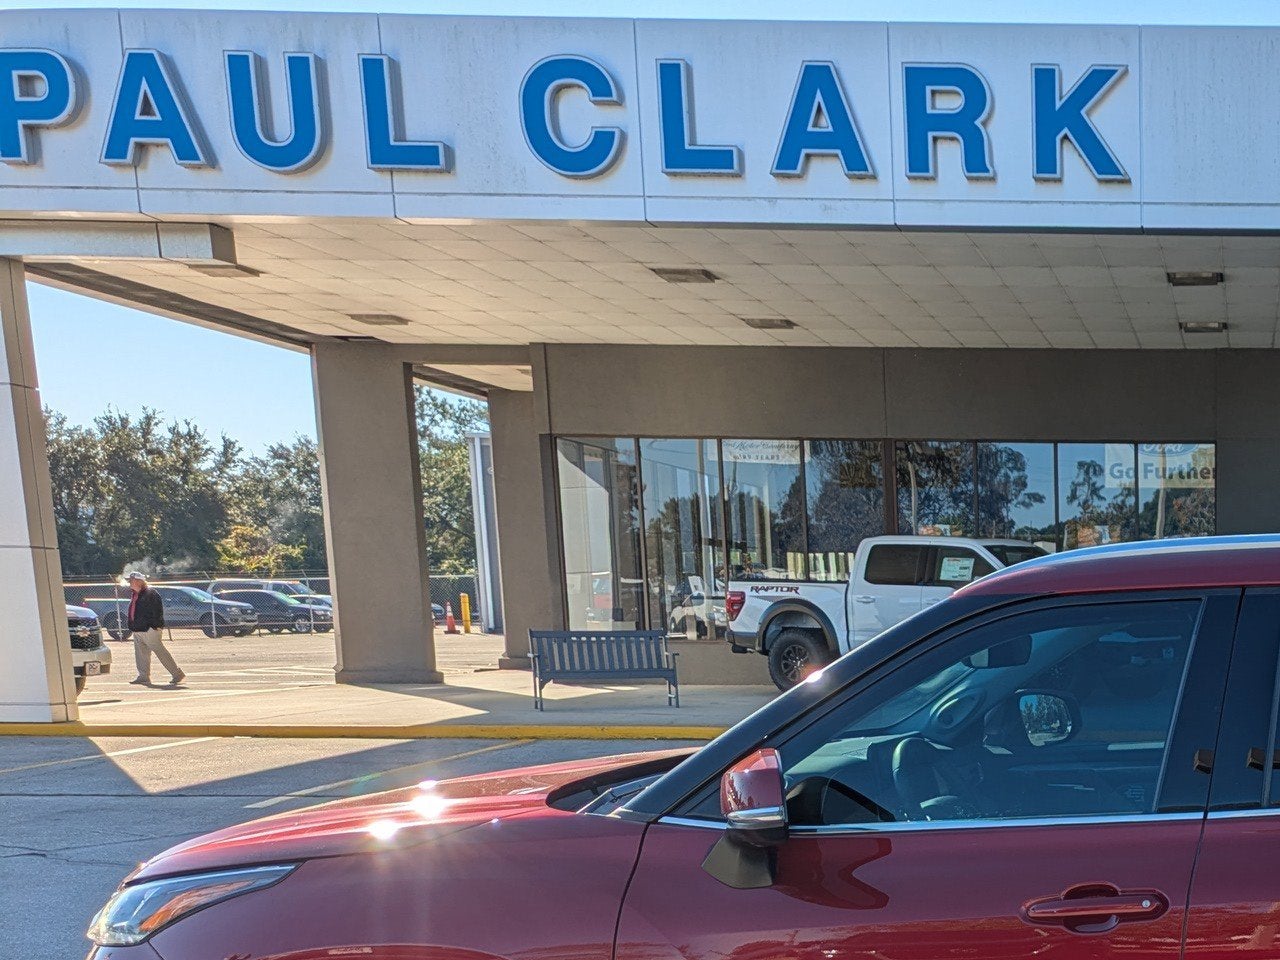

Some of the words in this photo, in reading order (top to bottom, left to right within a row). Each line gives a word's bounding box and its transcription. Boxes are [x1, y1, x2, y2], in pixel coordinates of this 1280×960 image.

[0, 47, 450, 174] PAUL
[519, 54, 1130, 182] CLARK
[750, 585, 801, 596] RAPTOR
